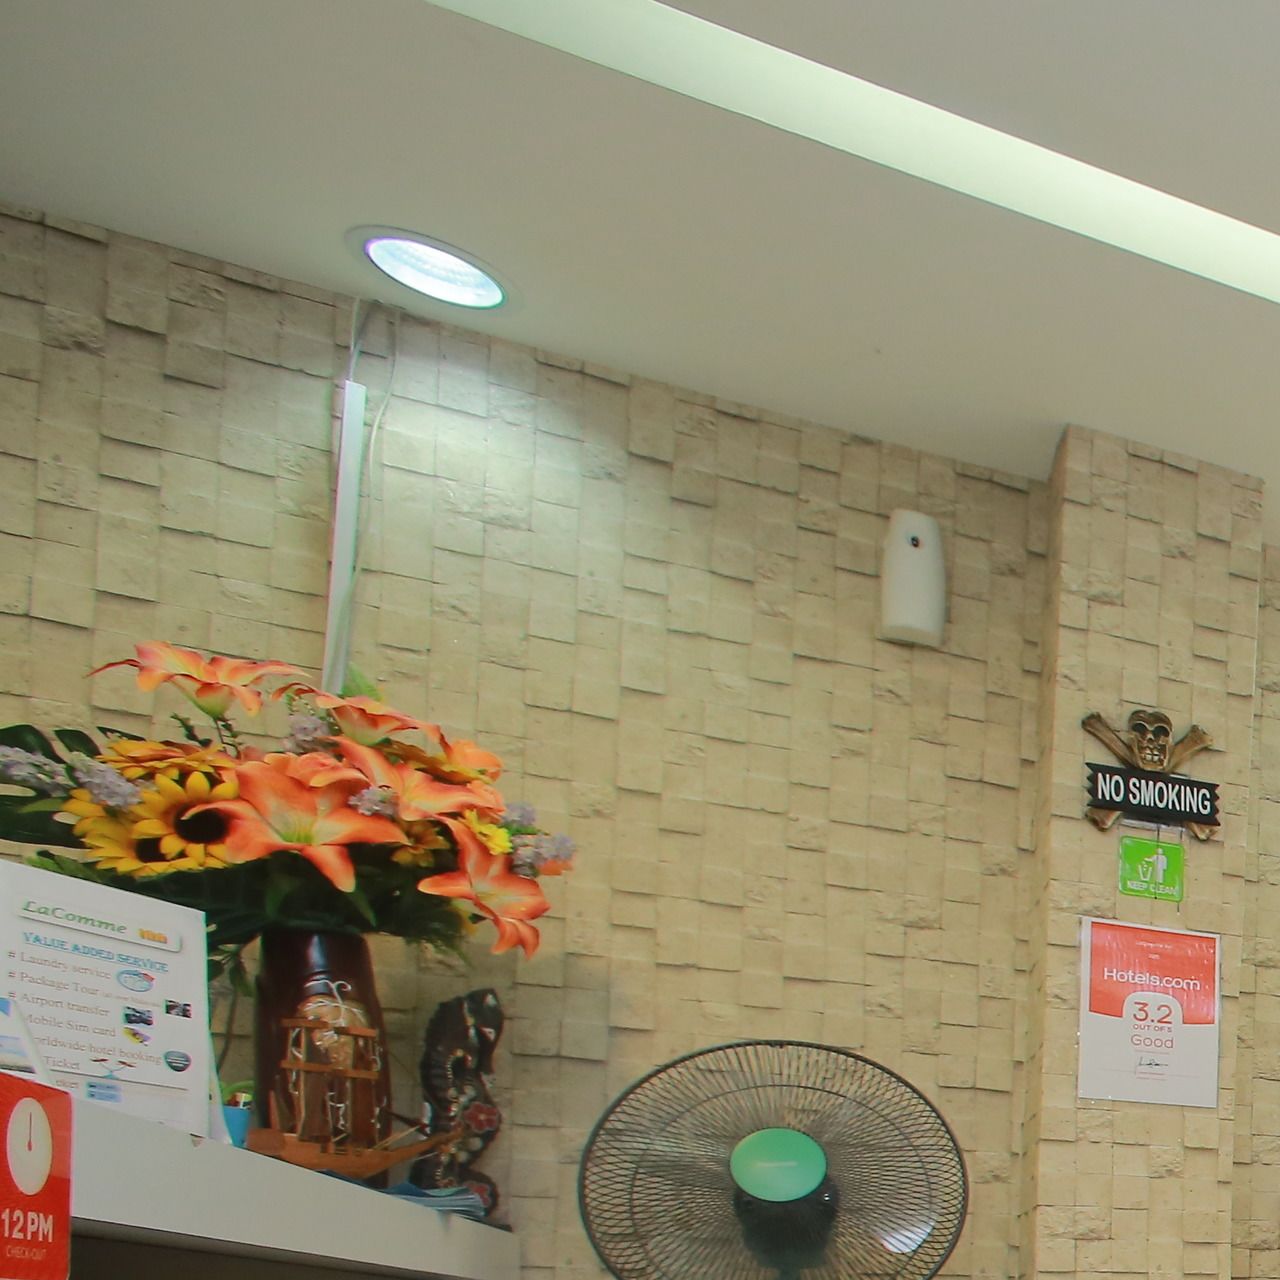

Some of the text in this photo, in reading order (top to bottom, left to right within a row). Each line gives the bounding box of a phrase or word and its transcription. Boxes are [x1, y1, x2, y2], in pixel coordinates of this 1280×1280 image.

[1097, 772, 1211, 815] NO SMOKING
[22, 900, 127, 934] LaComme
[1104, 967, 1201, 990] Hotels.com
[1133, 1001, 1173, 1024] 3.2
[1131, 1034, 1174, 1049] Good
